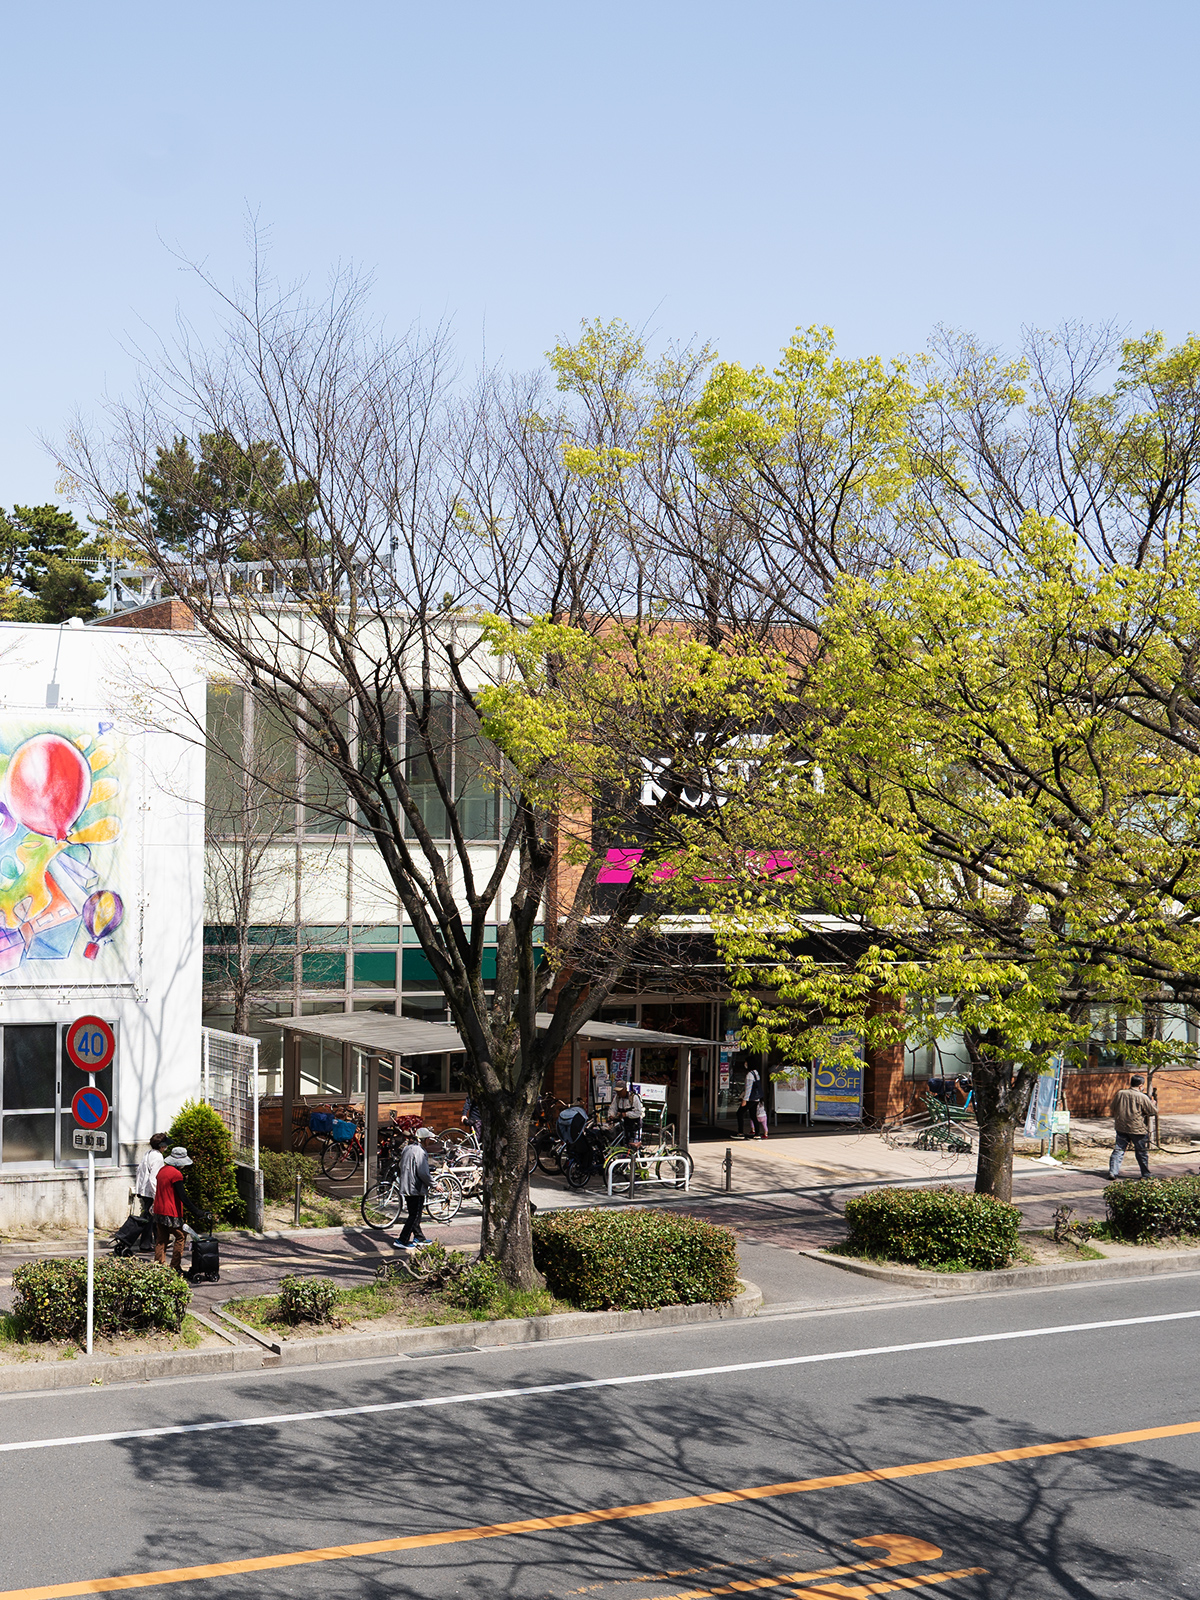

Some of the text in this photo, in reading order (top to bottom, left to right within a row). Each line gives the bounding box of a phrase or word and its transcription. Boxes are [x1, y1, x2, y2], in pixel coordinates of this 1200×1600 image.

[78, 1032, 103, 1057] 40
[75, 1134, 105, 1147] 自動車
